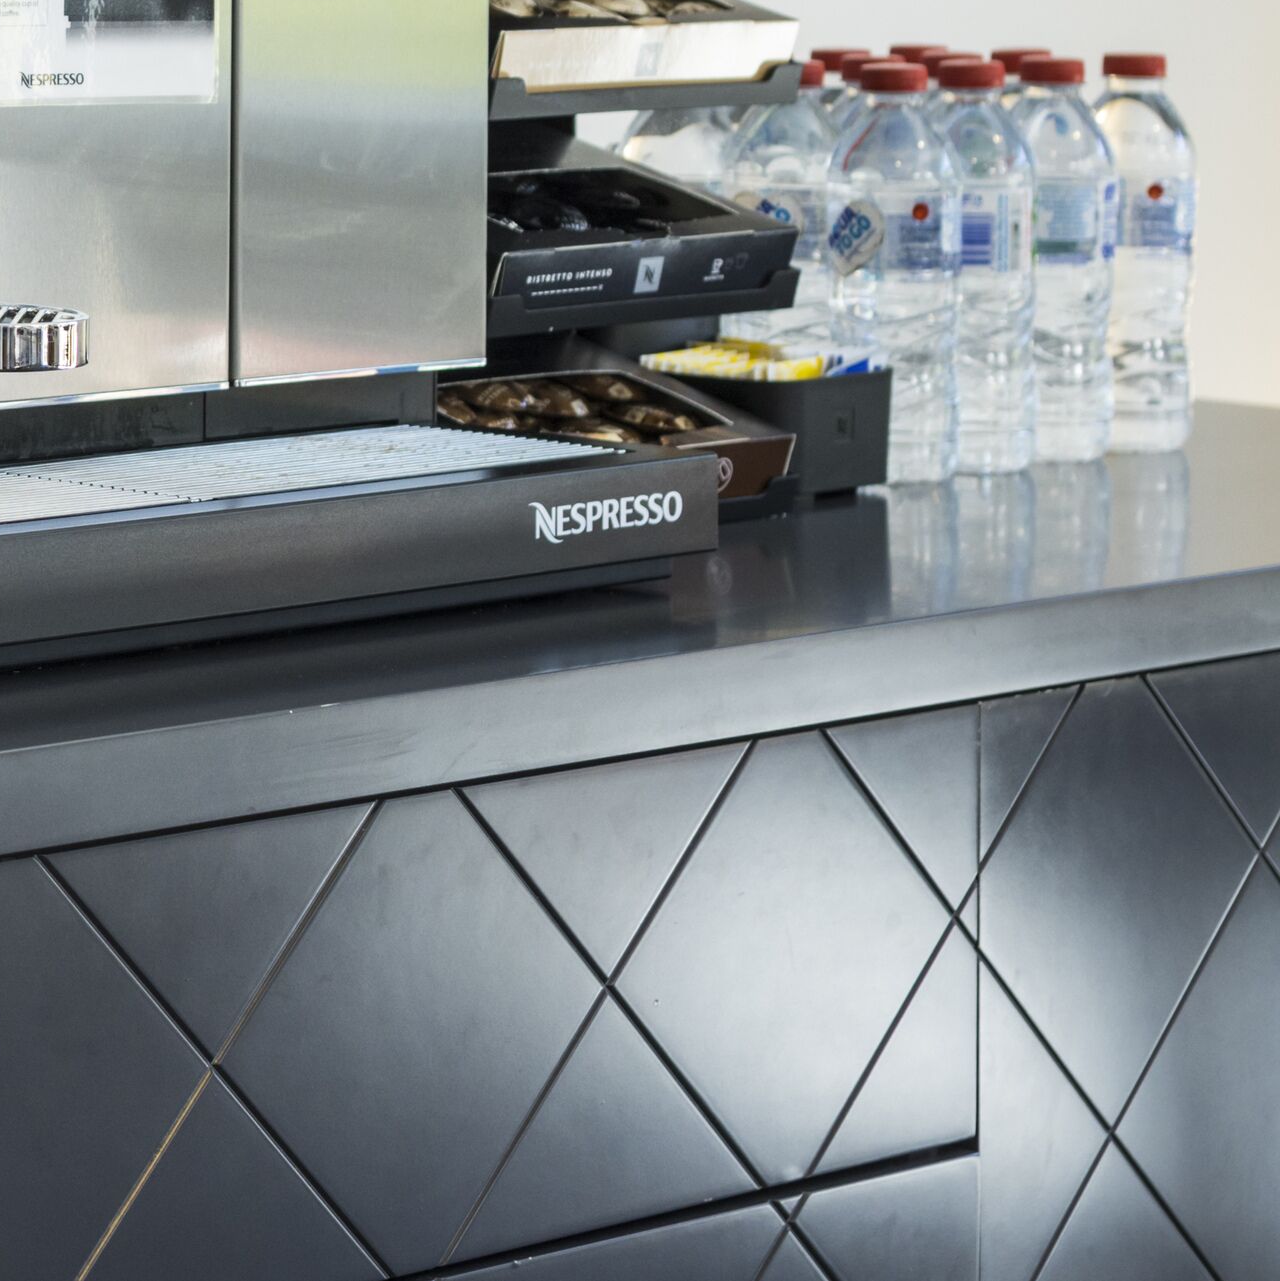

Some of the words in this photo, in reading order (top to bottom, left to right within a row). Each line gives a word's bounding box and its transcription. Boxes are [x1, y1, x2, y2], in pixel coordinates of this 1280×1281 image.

[20, 72, 85, 89] NESPRESSO
[525, 271, 574, 285] RISTRETTO
[575, 267, 613, 281] INTENSO
[529, 490, 683, 544] NESPRESSO
